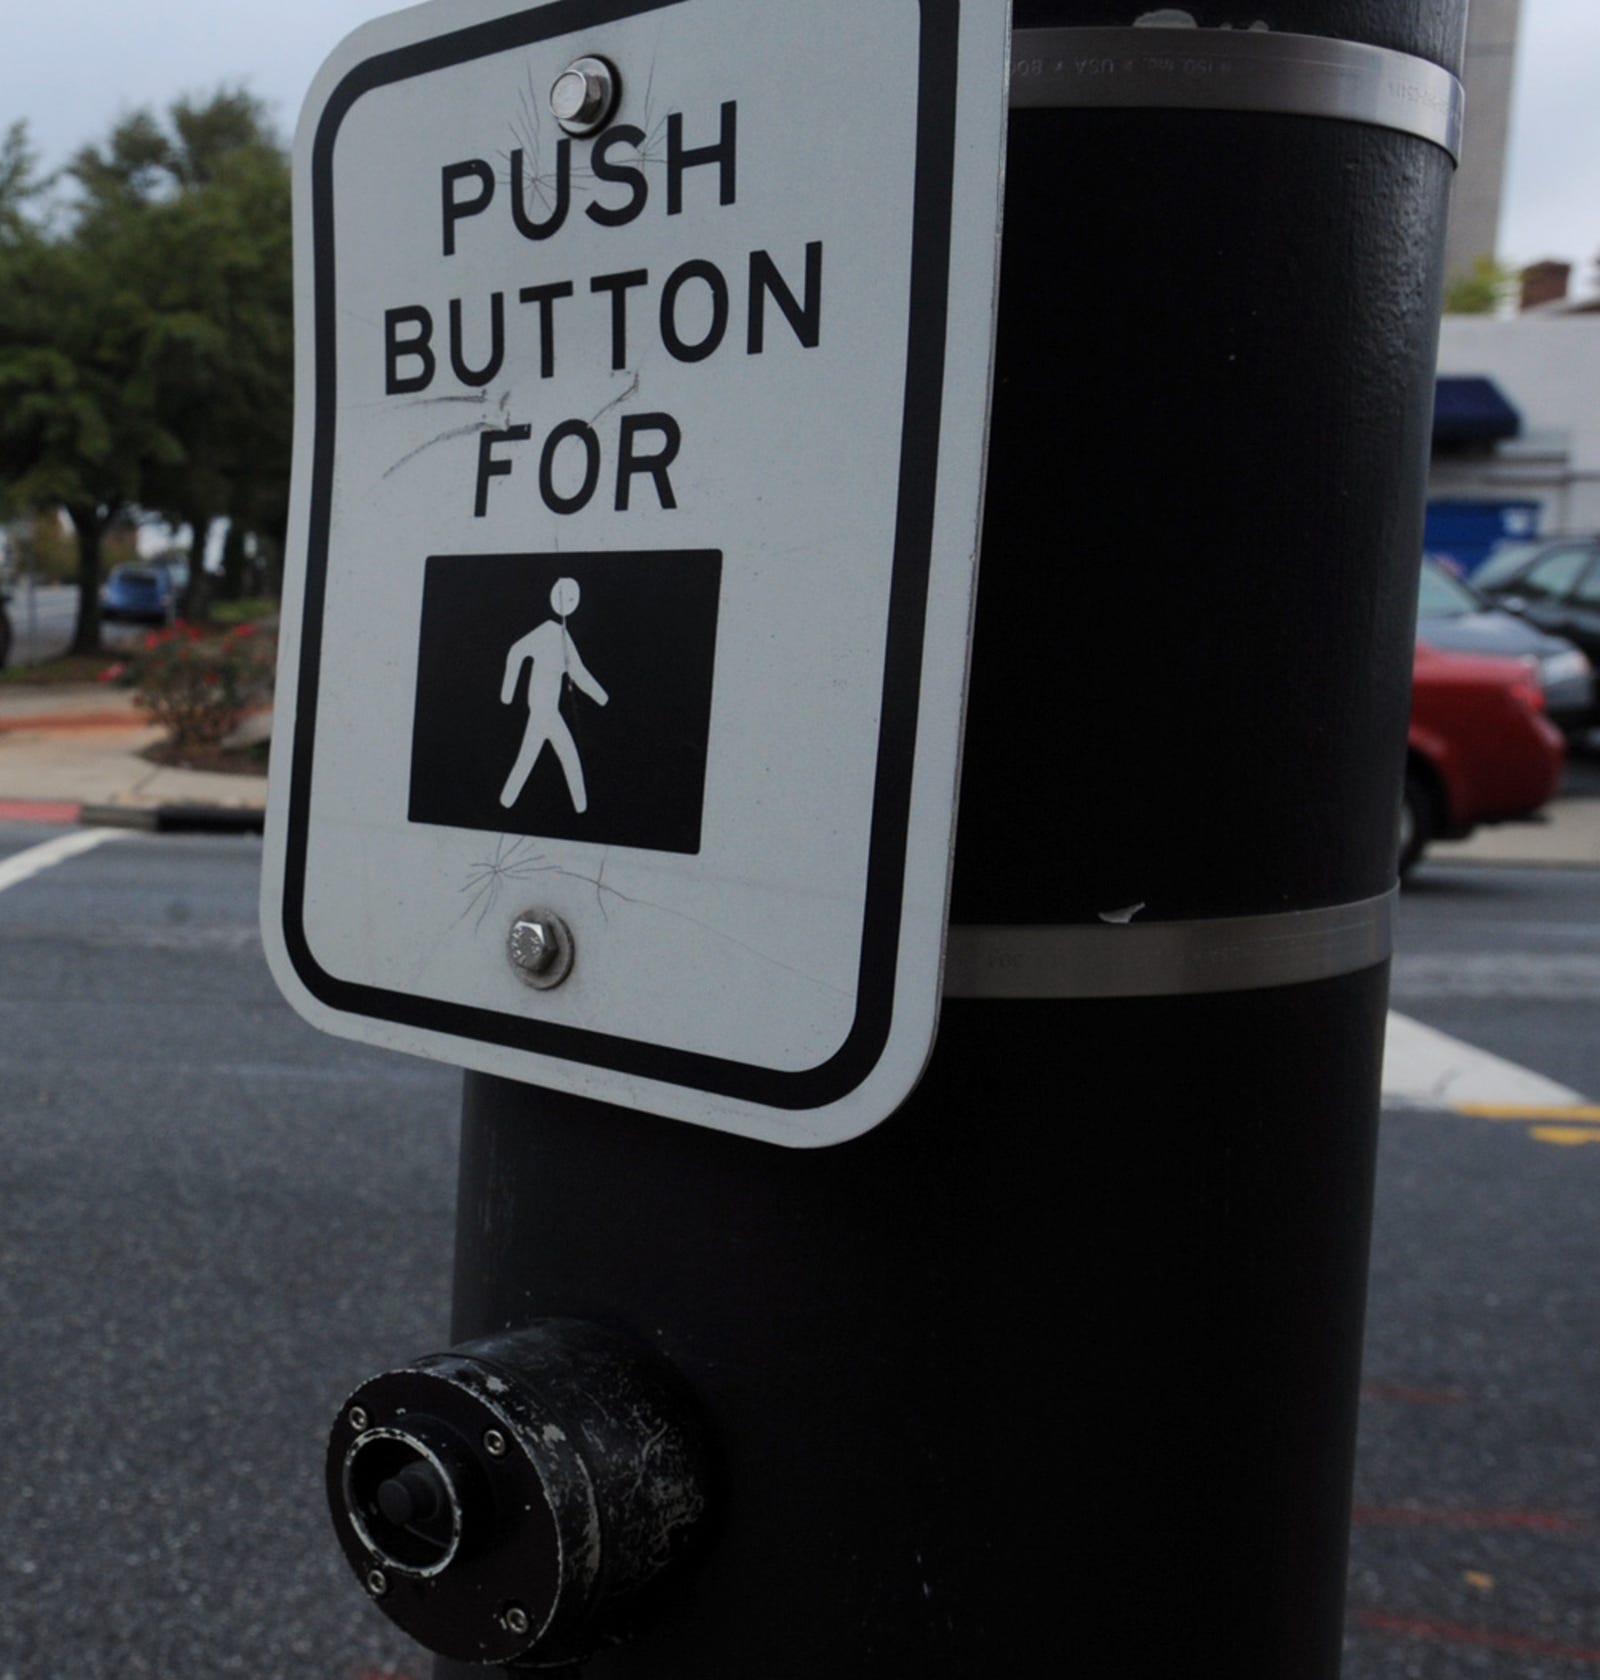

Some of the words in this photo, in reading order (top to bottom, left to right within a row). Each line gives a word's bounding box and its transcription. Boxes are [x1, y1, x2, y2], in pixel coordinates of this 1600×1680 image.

[441, 100, 737, 257] PUSH
[384, 240, 823, 396] BUTTON
[473, 412, 681, 518] FOR
